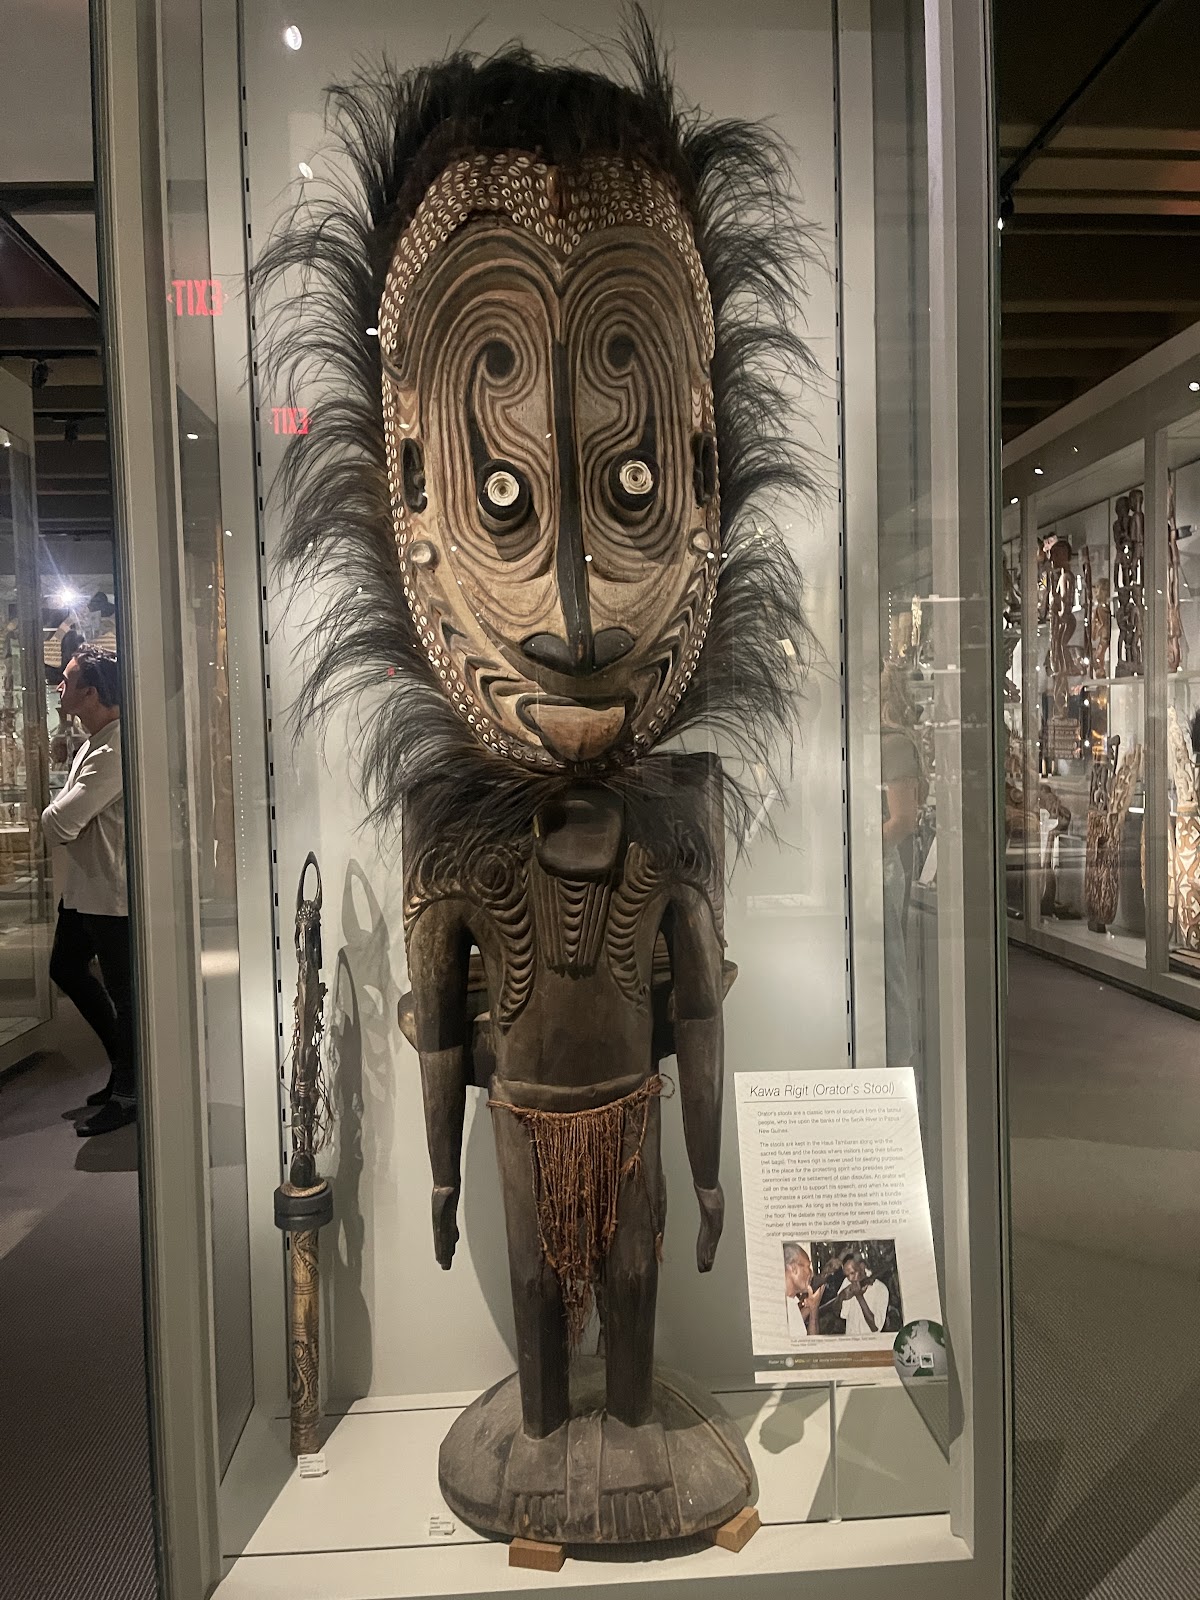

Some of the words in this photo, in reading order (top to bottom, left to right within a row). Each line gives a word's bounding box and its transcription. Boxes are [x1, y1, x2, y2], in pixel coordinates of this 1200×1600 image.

[750, 1086, 780, 1097] Kawa
[784, 1084, 808, 1099] Rigit
[812, 1083, 860, 1098] (Orator's
[864, 1082, 895, 1096] Stool)
